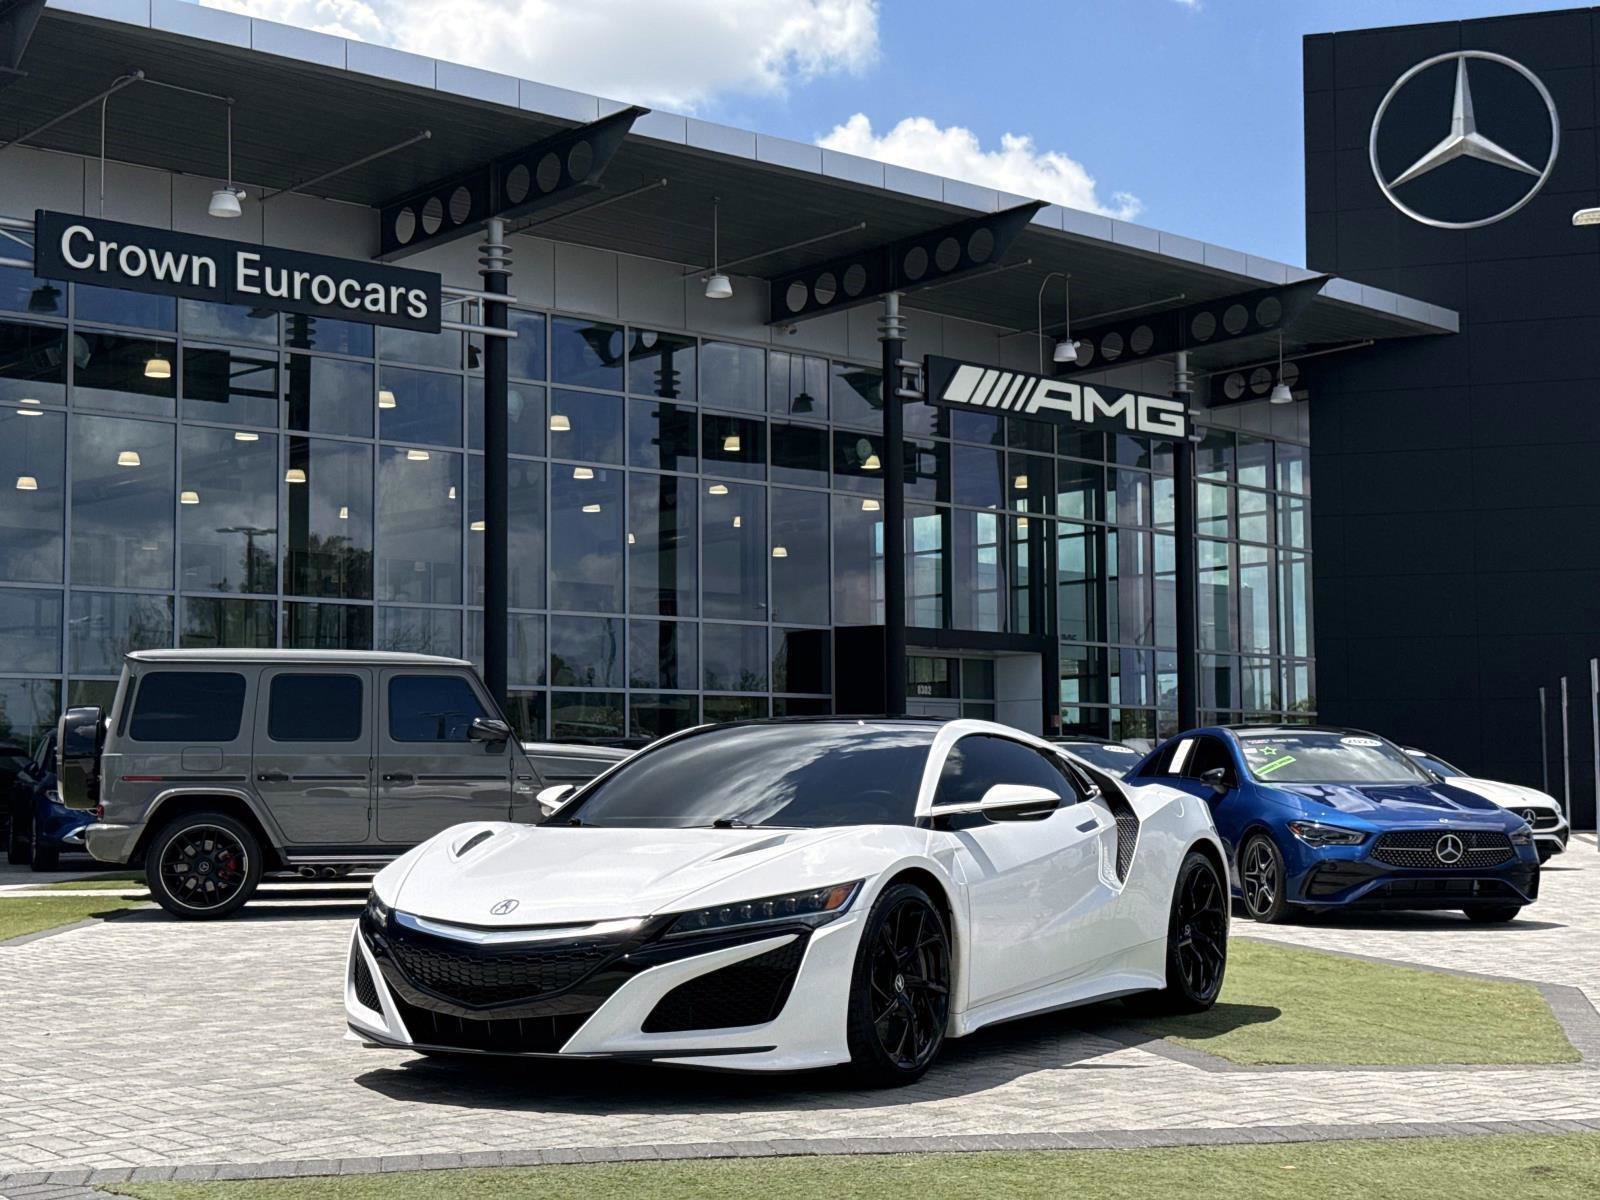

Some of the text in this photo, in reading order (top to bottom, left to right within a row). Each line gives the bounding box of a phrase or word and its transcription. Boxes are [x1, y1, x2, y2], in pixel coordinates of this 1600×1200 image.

[61, 225, 428, 319] Crown Eurocars
[1025, 379, 1185, 437] AMG
